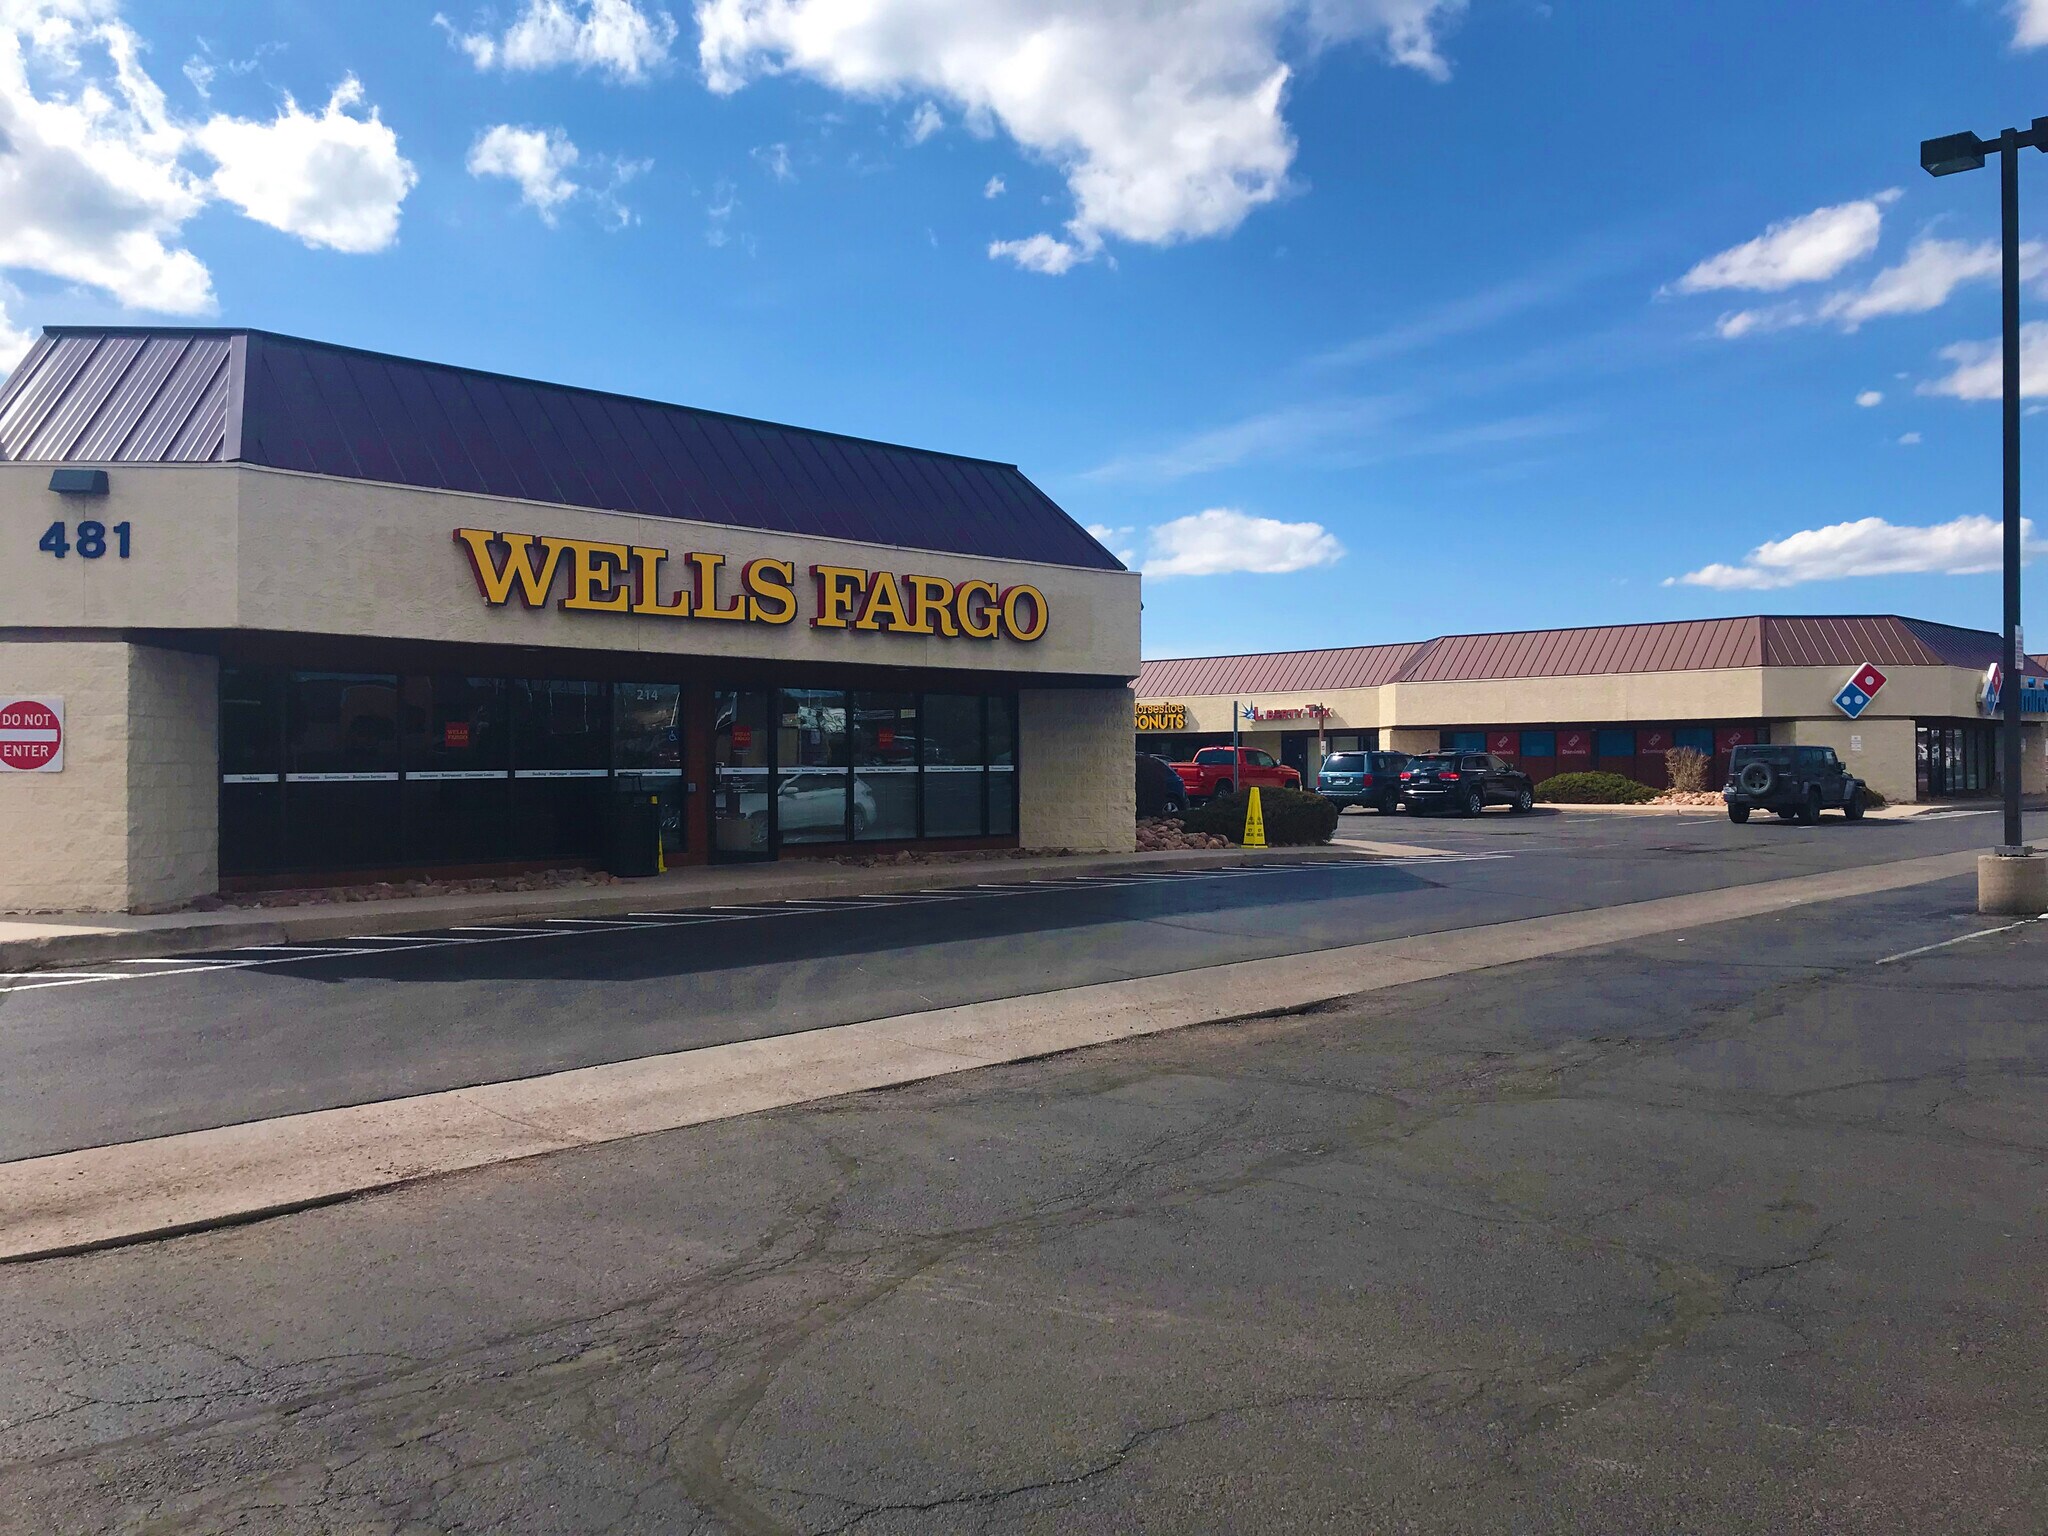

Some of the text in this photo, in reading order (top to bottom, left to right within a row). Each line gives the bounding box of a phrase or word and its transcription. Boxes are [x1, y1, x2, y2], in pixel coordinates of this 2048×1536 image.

[39, 521, 131, 559] 481
[452, 527, 1050, 642] WELLS FARGO
[636, 689, 659, 701] 214
[1135, 702, 1184, 714] orseshoe
[2, 713, 51, 726] DO NOT
[1135, 713, 1185, 730] ONUTS
[3, 744, 49, 757] ENTER
